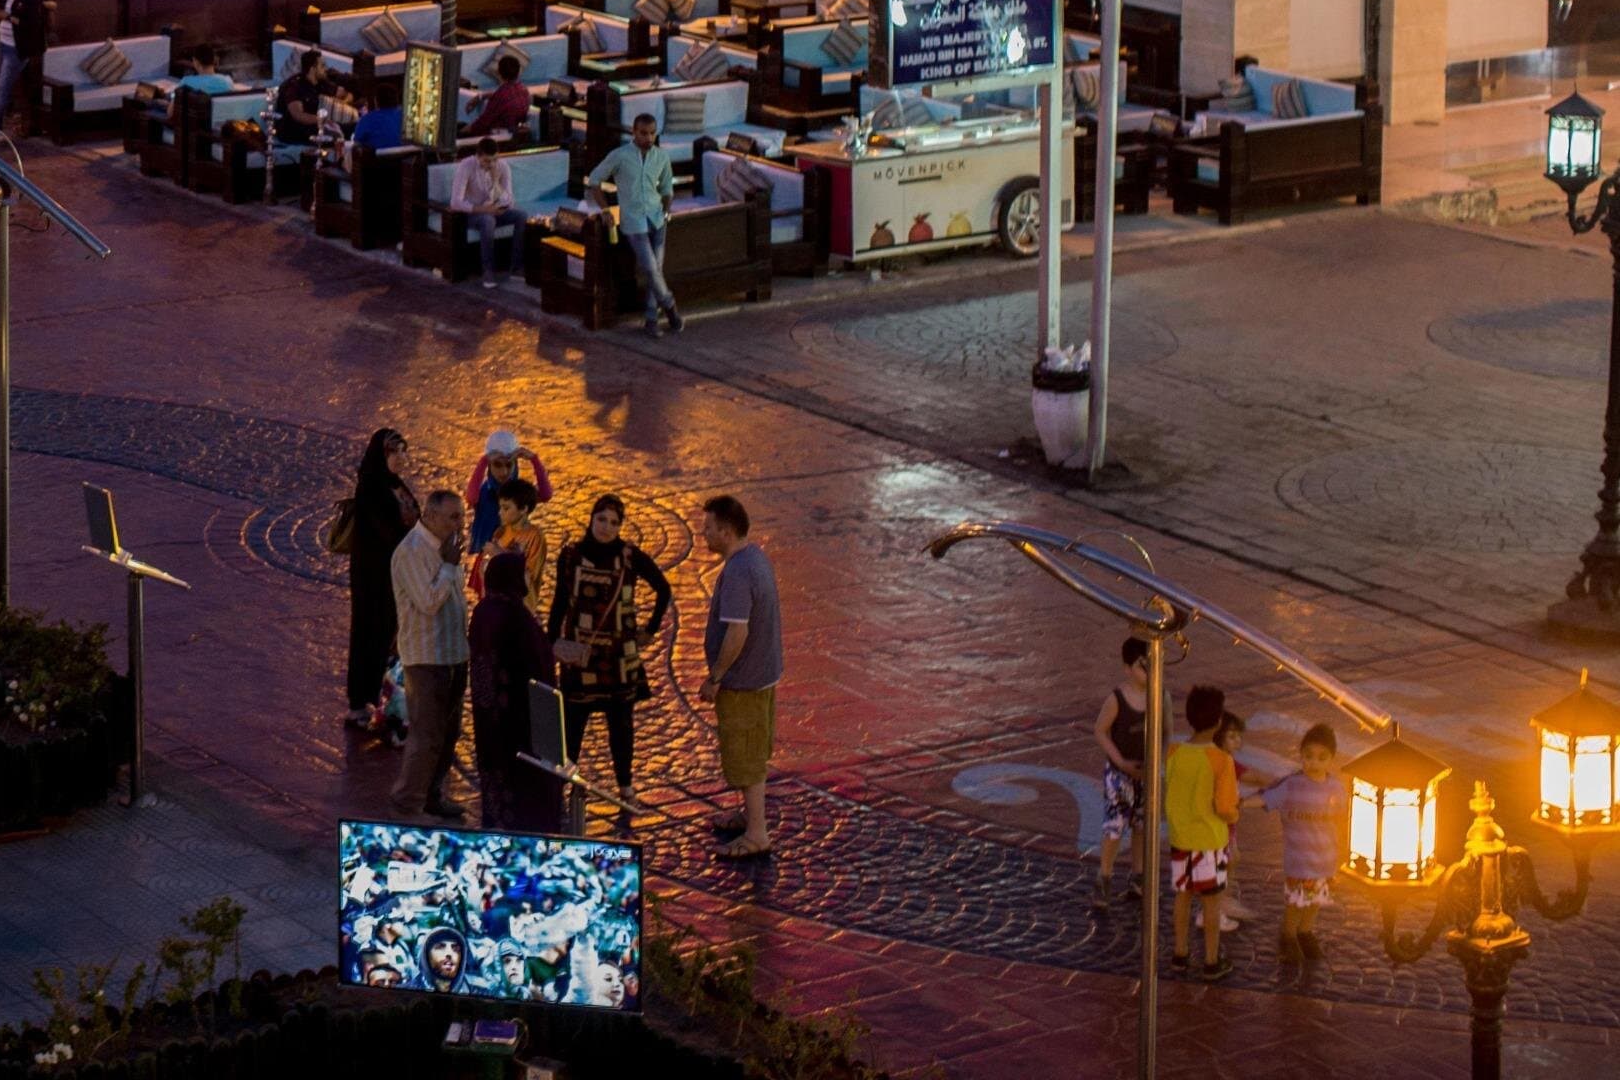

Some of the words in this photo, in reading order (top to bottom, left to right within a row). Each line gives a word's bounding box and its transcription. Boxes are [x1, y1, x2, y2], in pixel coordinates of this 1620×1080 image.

[920, 34, 942, 49] HIS
[900, 52, 936, 68] HAMAD
[957, 46, 974, 60] ISA
[920, 64, 952, 80] KING
[954, 62, 972, 75] OF
[873, 160, 966, 180] MÖVENPICK
